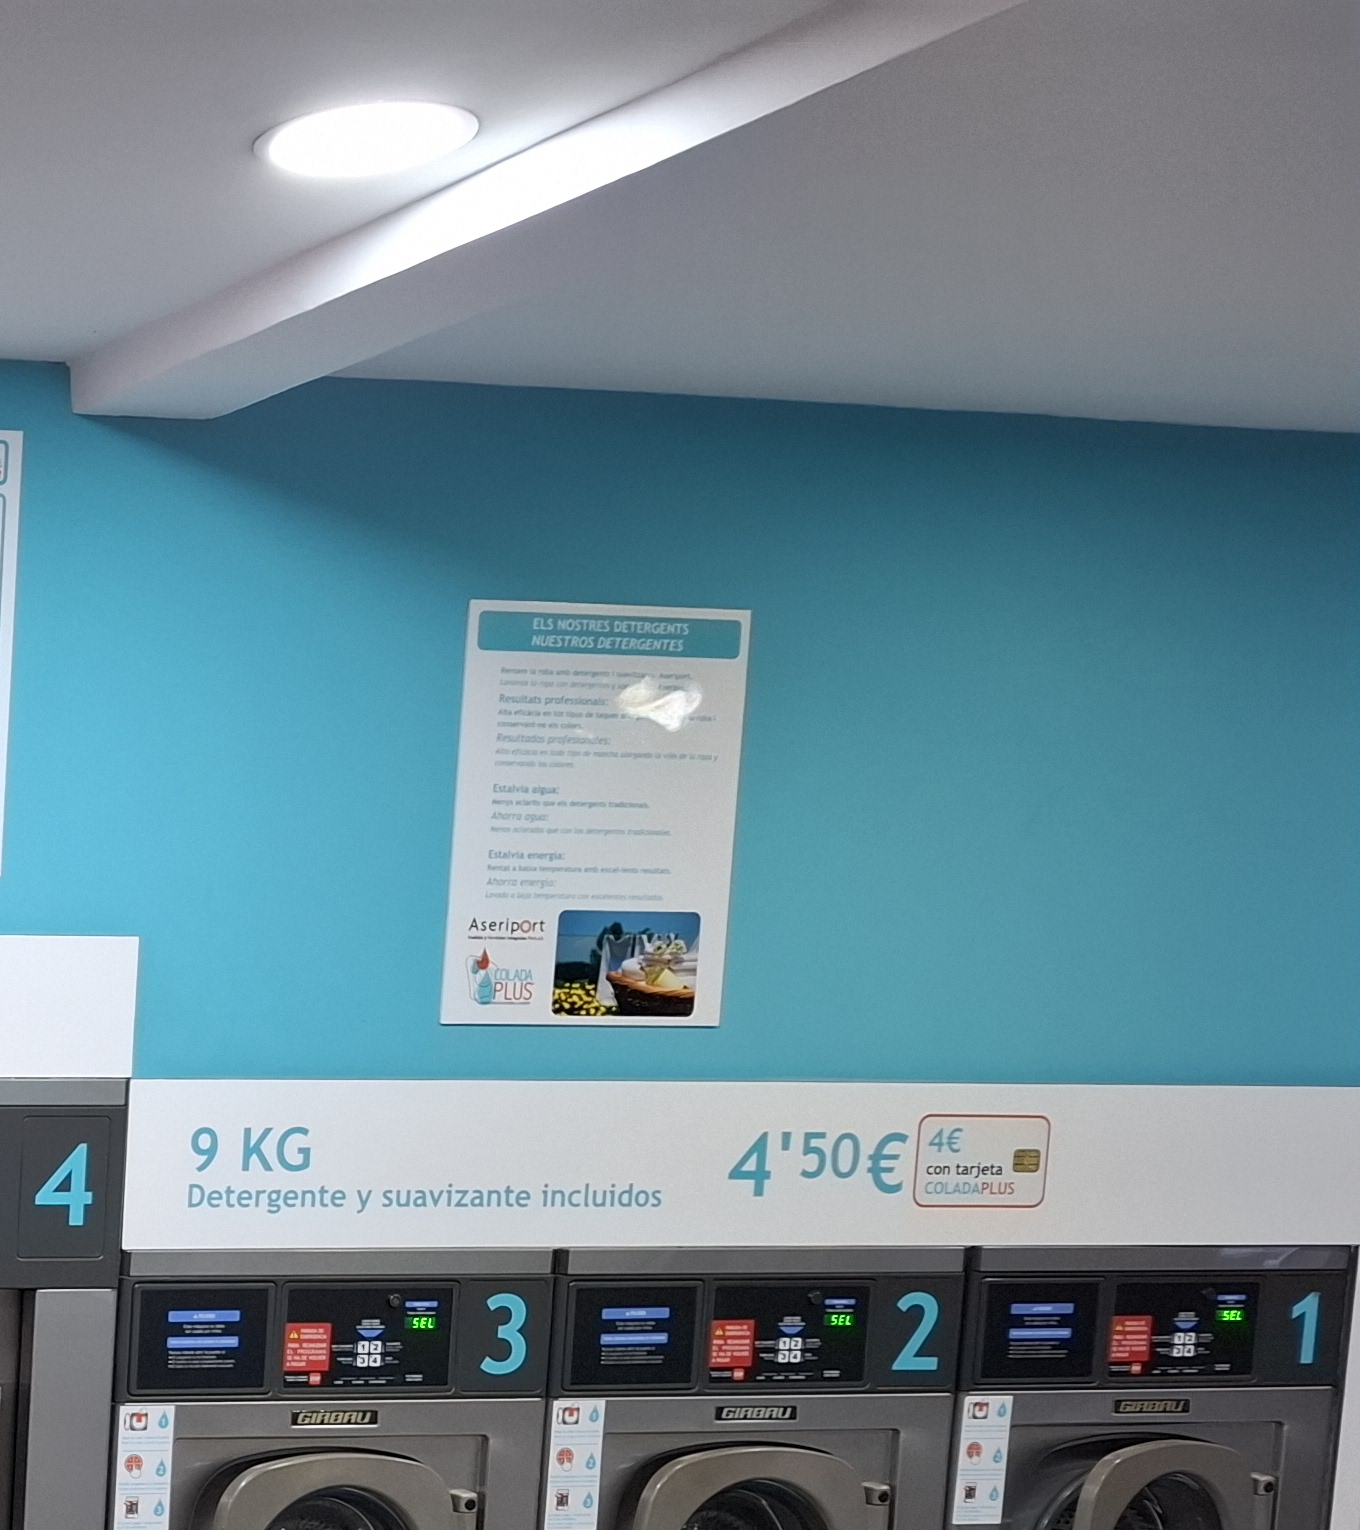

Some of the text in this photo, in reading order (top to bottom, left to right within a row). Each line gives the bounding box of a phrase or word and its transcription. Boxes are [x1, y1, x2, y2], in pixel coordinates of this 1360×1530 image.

[533, 618, 689, 635] ELS NOSTRES DETERGENTS
[532, 635, 684, 652] NUESTROS DETERGENTES
[494, 969, 532, 981] COLADA
[493, 982, 534, 1000] PLUS
[191, 1126, 310, 1172] 9 KG
[928, 1127, 962, 1153] 4€
[926, 1162, 1002, 1178] con tarjeta
[34, 1143, 92, 1225] 4
[924, 1181, 1014, 1195] COLADAPLUS
[187, 1182, 661, 1213] Detergente y suavizante incluidos
[480, 1293, 526, 1374] 3
[891, 1291, 938, 1370] 2
[1291, 1292, 1319, 1363] 1
[297, 1411, 372, 1424] GIRBAU
[721, 1407, 792, 1419] GIRBAU
